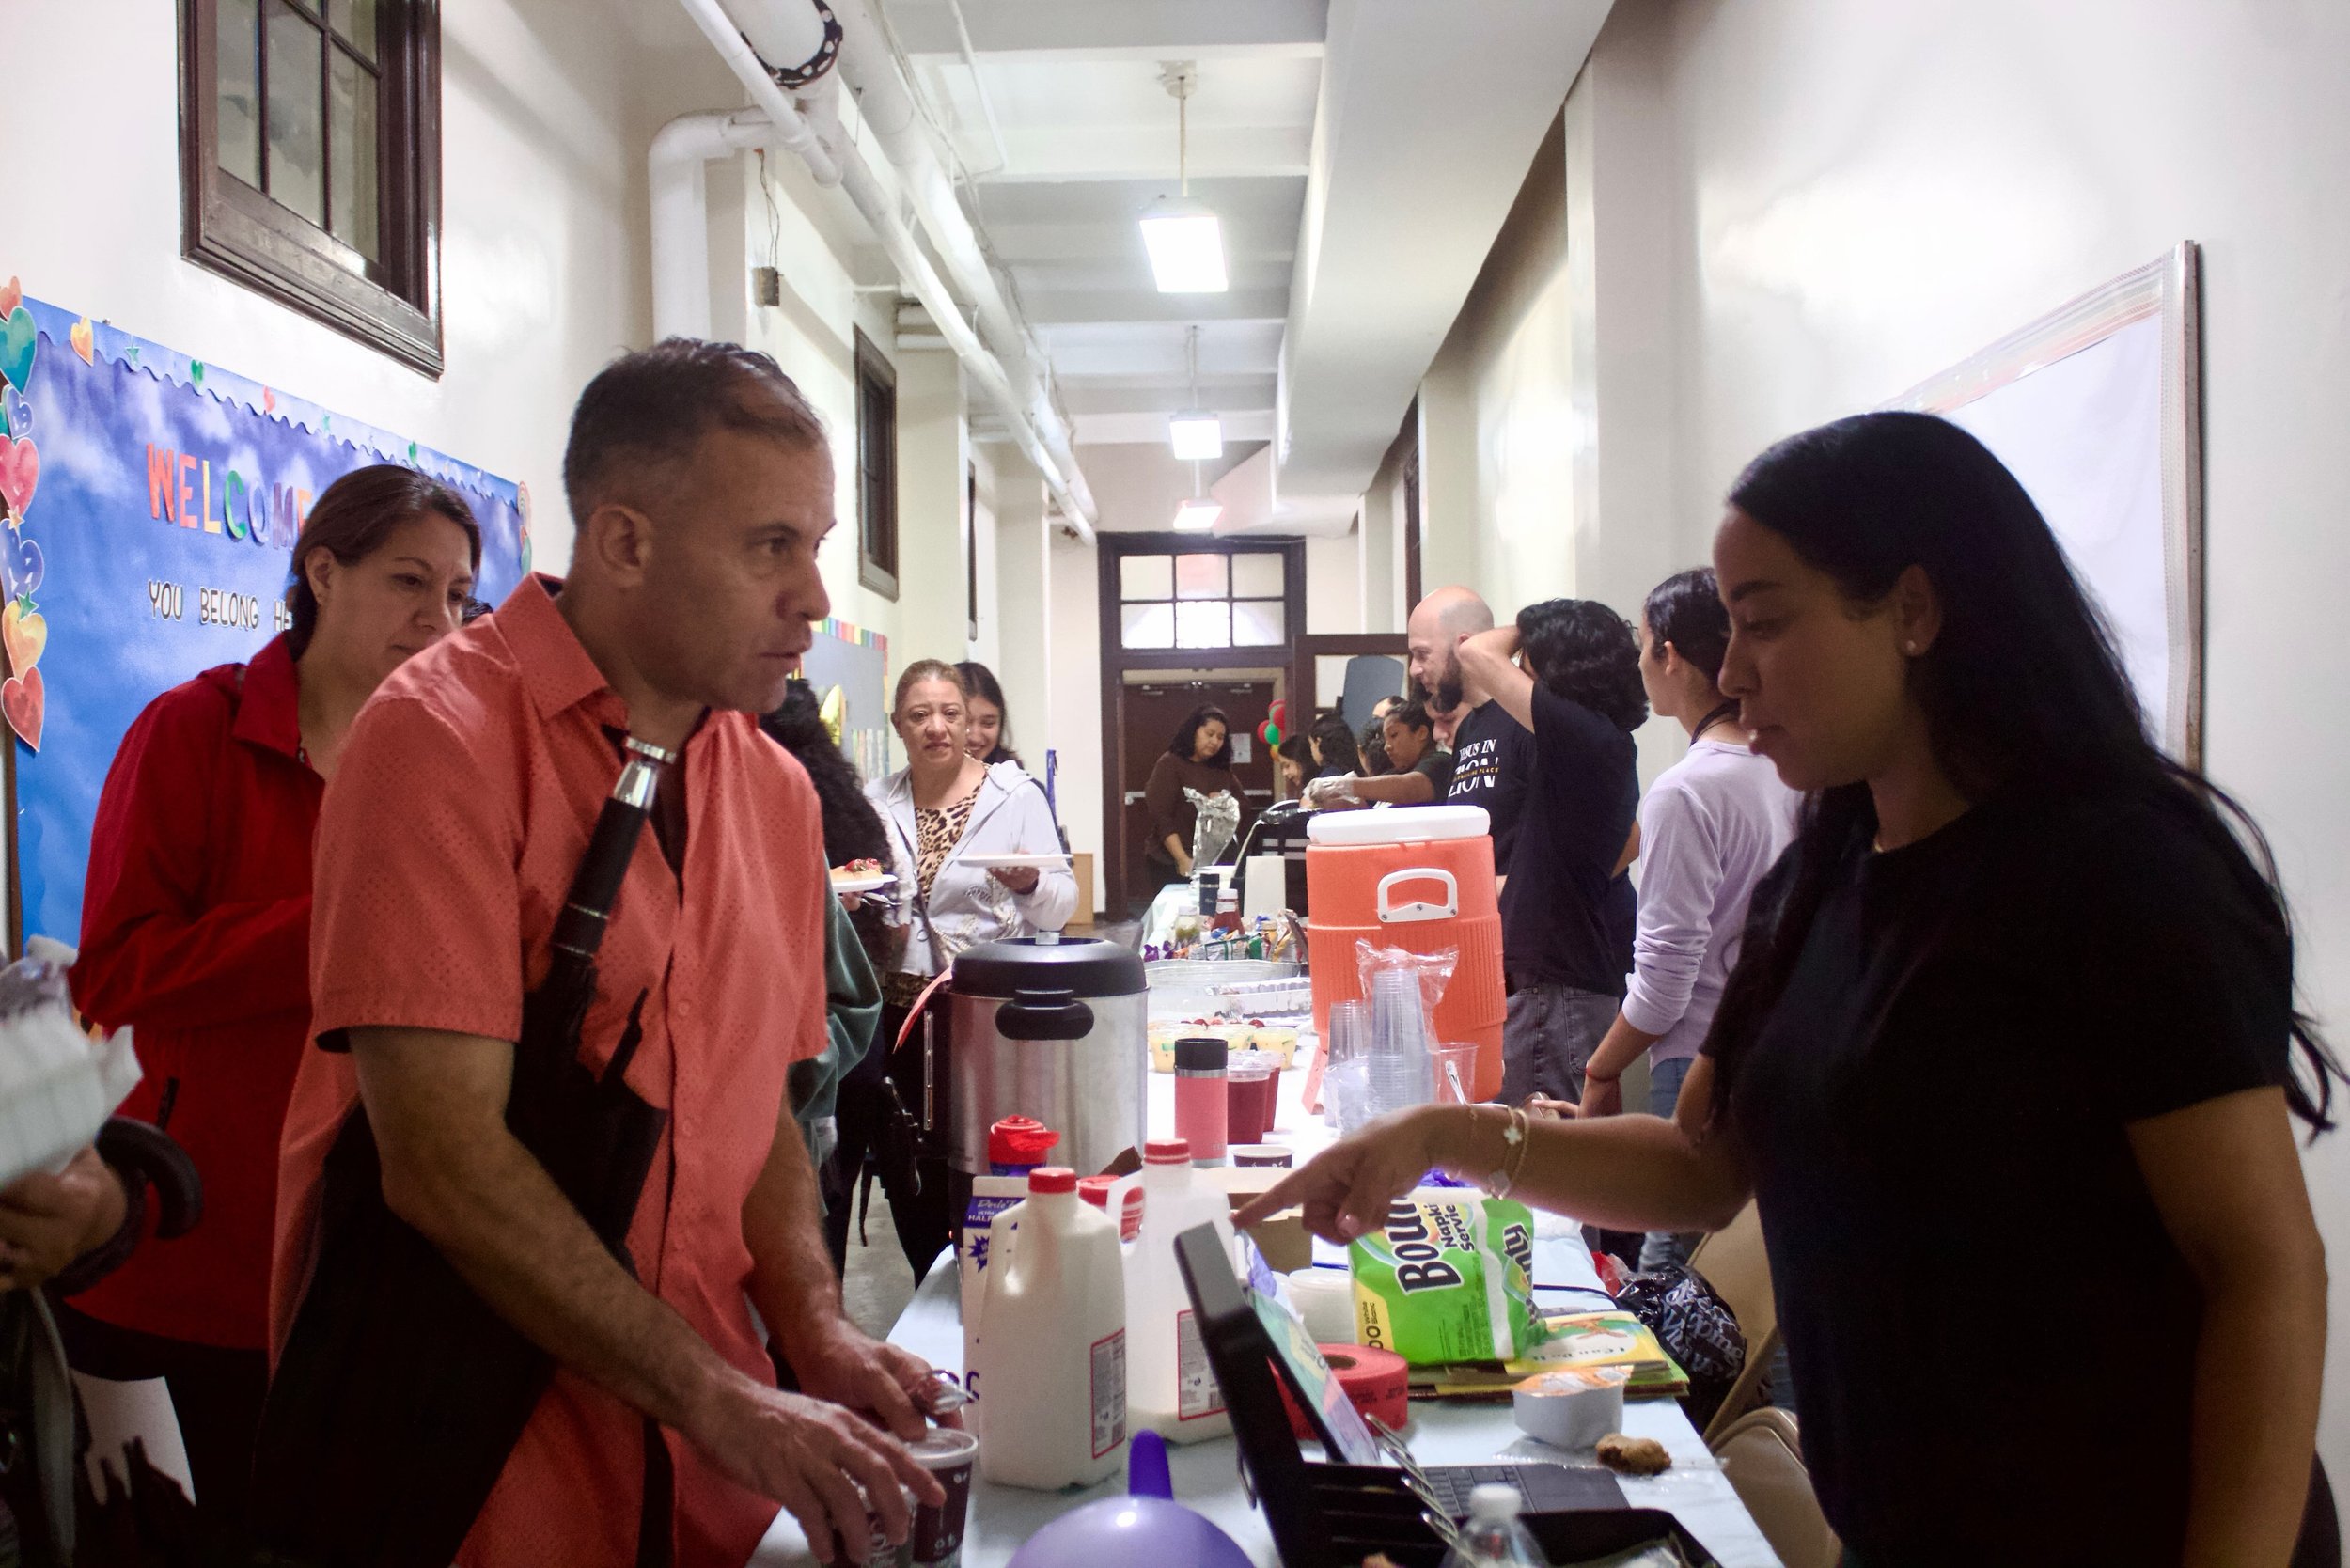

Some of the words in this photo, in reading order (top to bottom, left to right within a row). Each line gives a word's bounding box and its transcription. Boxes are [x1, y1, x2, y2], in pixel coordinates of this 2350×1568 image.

[149, 579, 183, 620] YOU
[200, 587, 259, 631] BELONG
[1481, 739, 1496, 753] IN
[1386, 1196, 1462, 1293] Bou
[1424, 1202, 1458, 1248] Napki
[1444, 1204, 1475, 1252] Servie
[1366, 1325, 1383, 1350] 00
